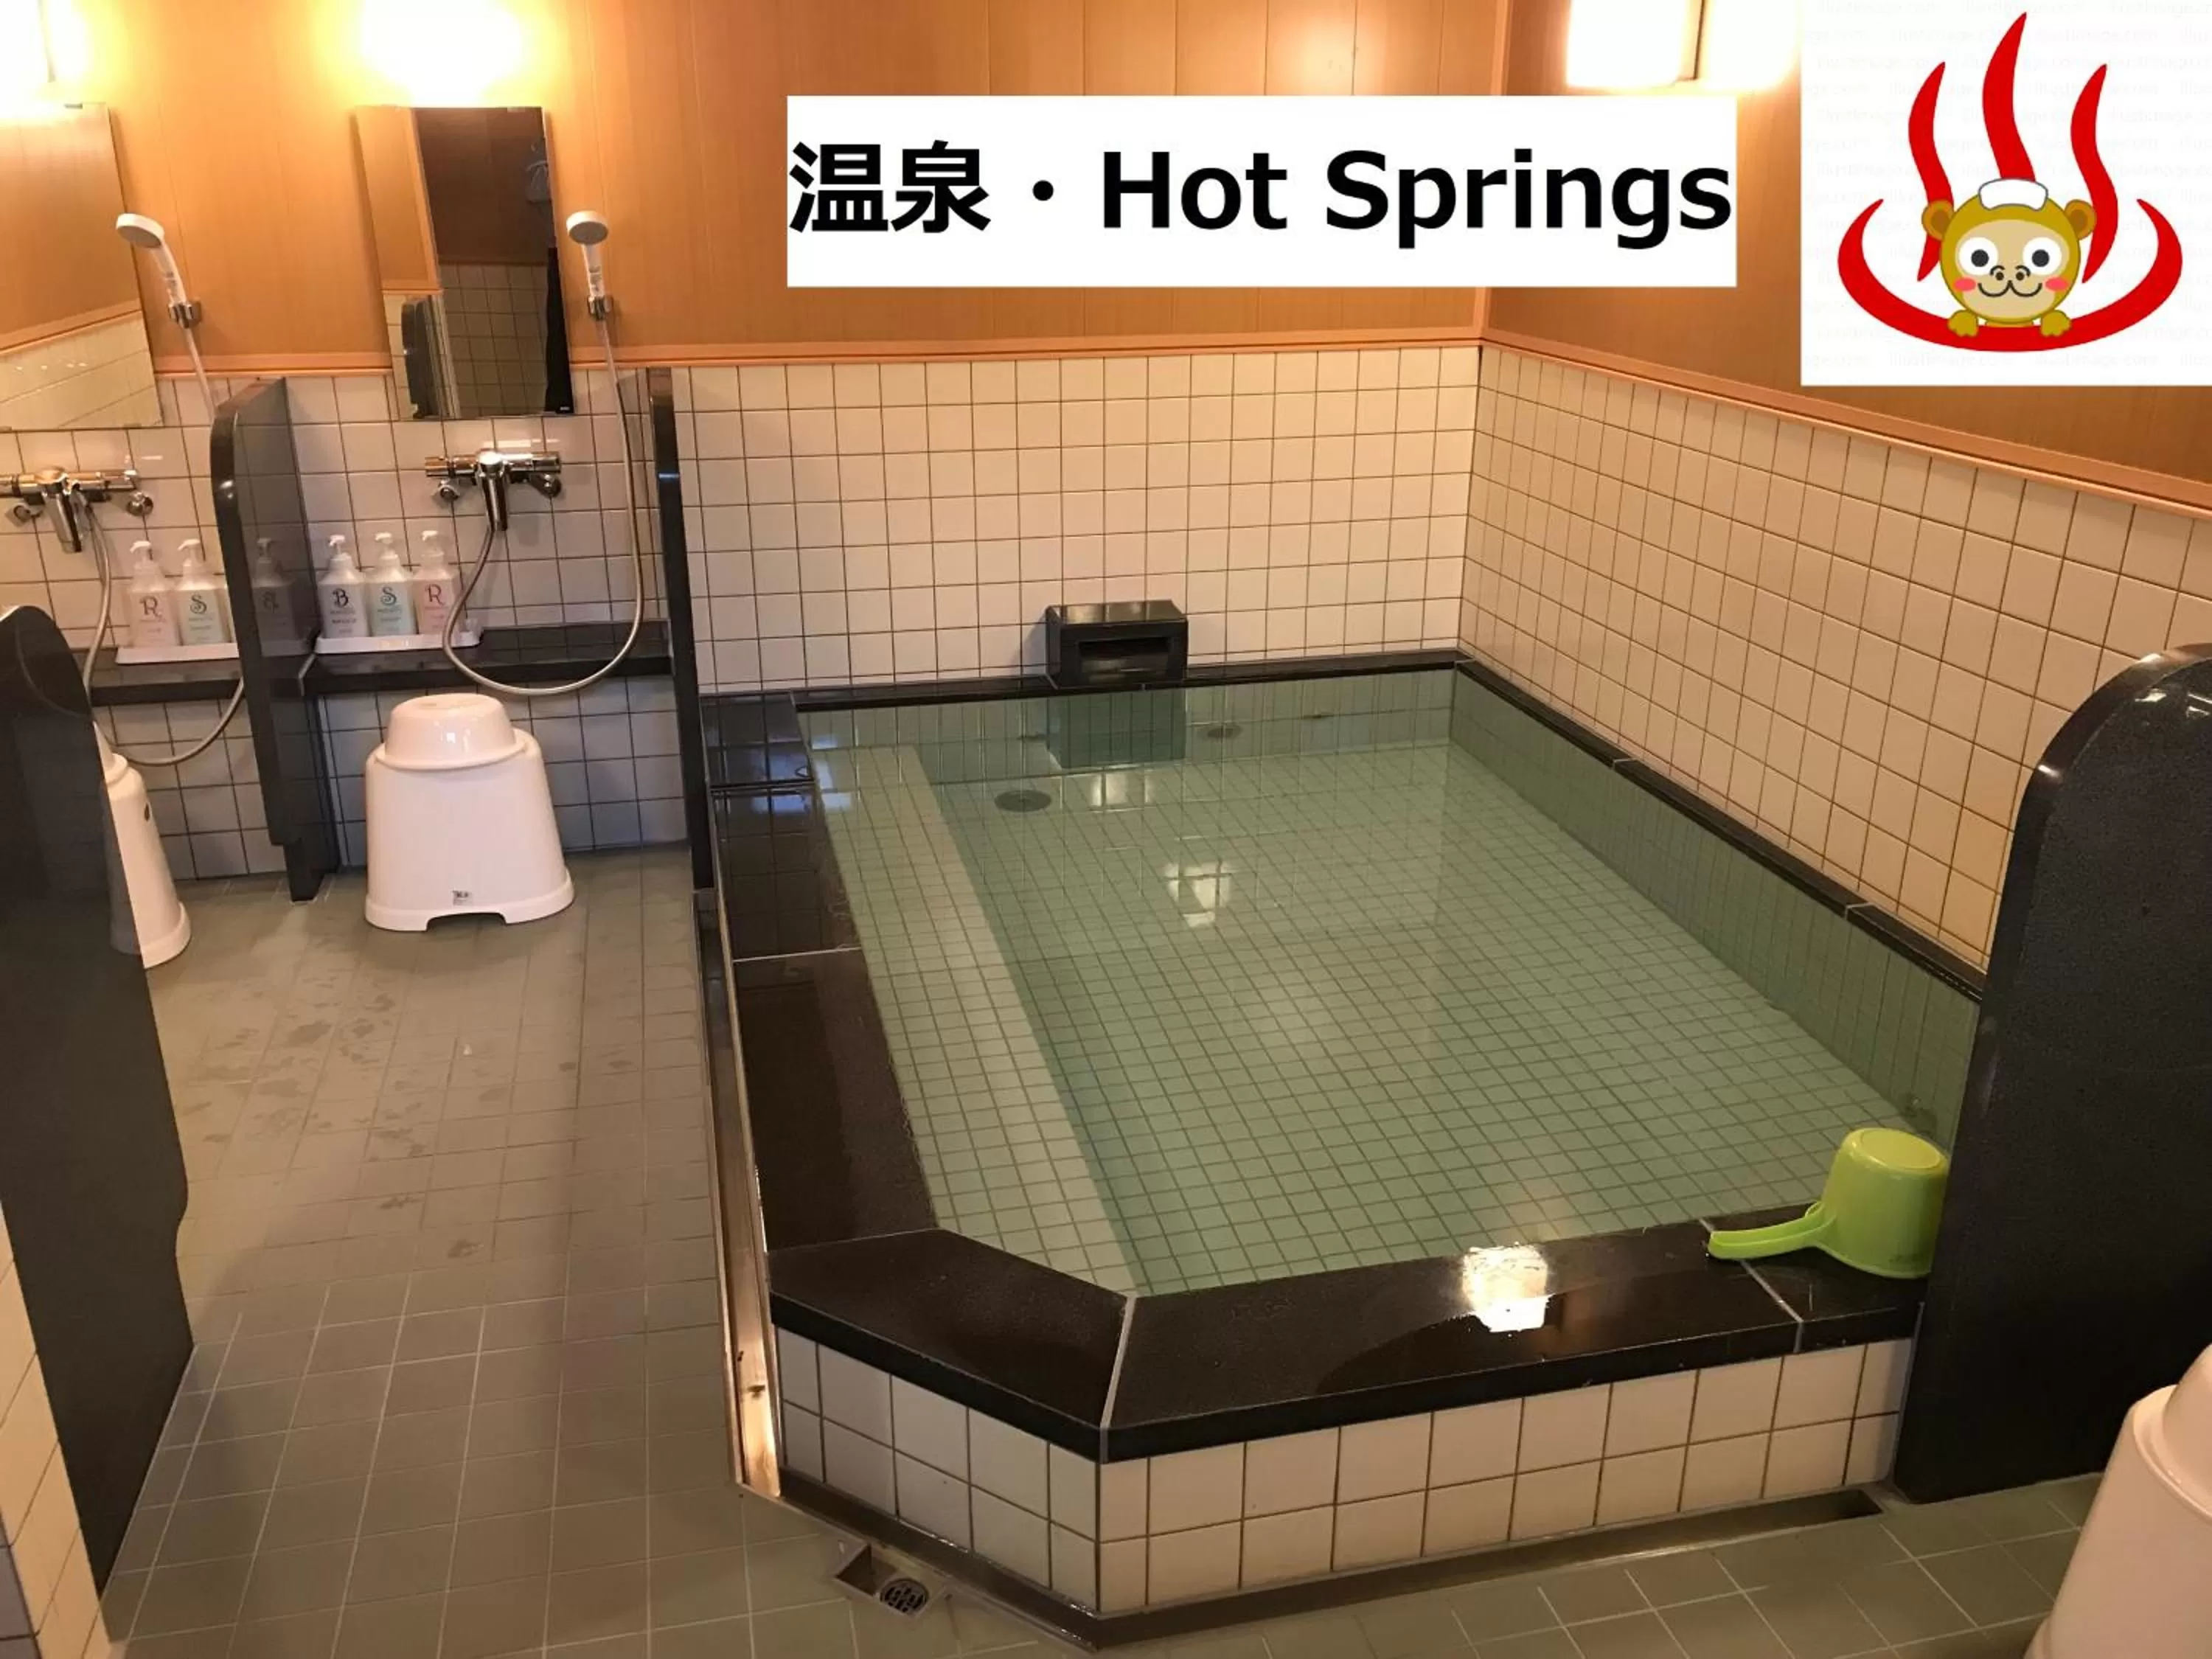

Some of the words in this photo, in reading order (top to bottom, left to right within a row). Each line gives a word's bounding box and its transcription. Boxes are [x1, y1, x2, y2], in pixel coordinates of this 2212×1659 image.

[189, 593, 207, 615] S
[332, 588, 349, 608] B
[380, 586, 397, 606] S
[424, 583, 445, 605] R
[139, 595, 162, 618] R
